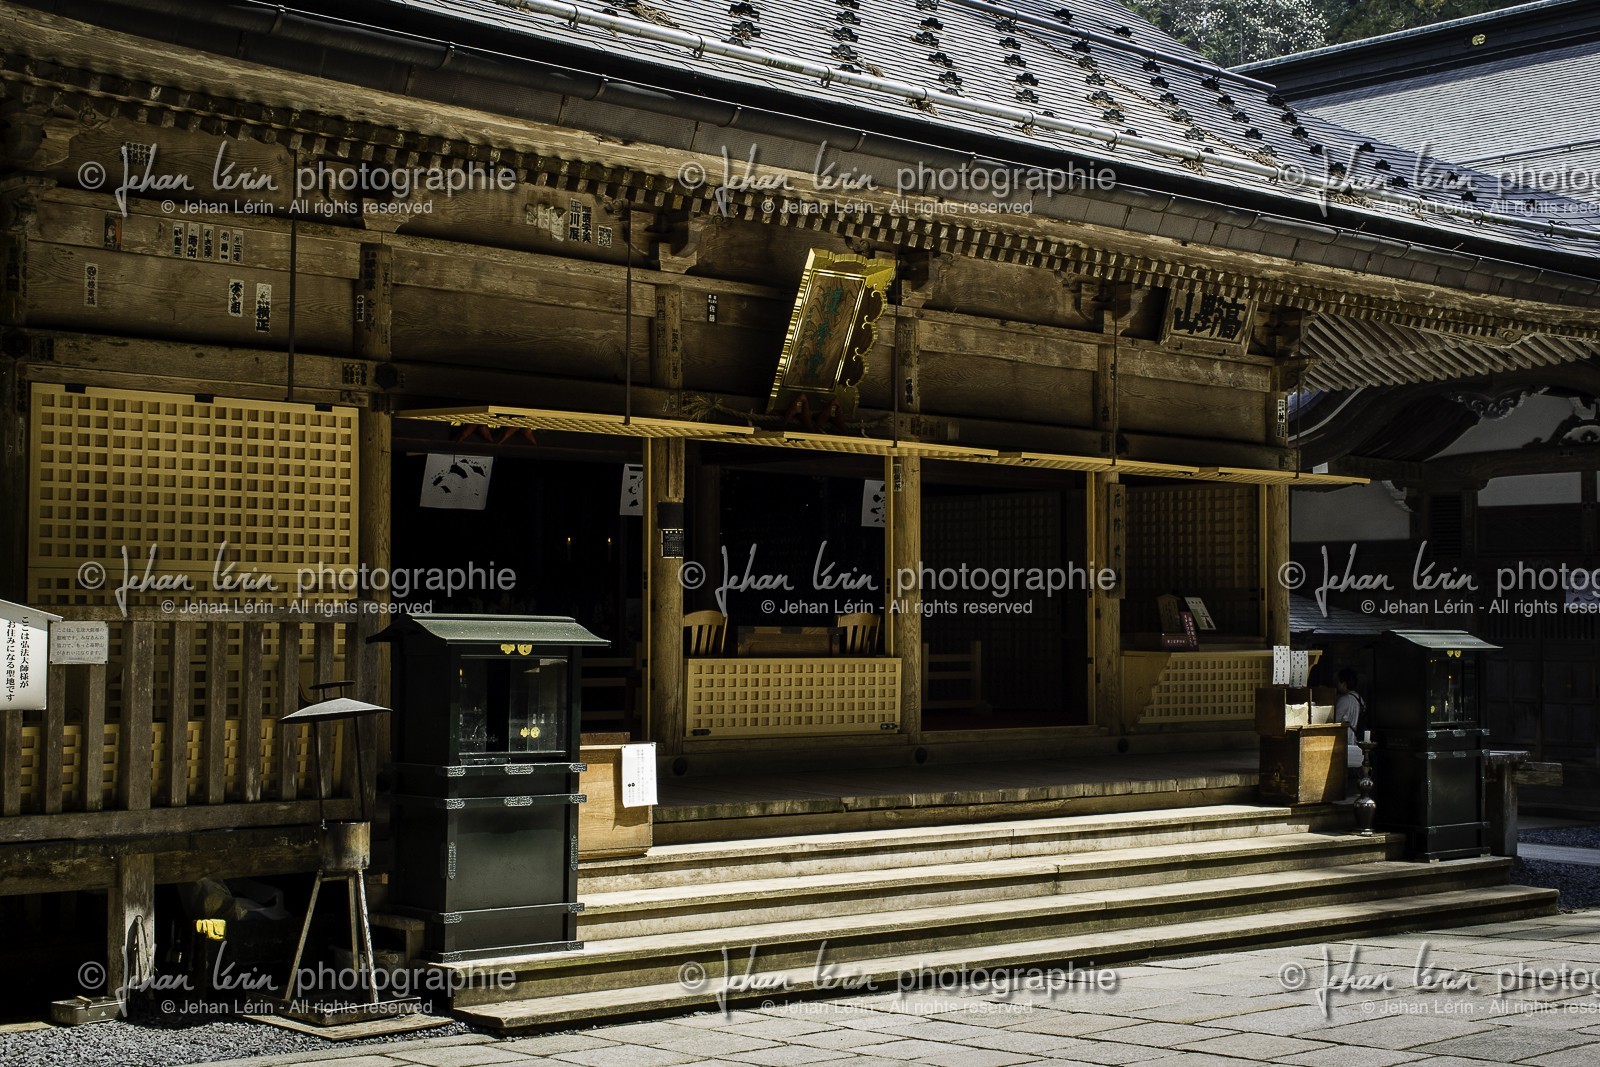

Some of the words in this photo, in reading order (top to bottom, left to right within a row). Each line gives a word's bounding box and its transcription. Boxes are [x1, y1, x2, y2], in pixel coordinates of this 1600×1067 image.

[6, 620, 16, 702] お住みになる聖地です
[20, 616, 30, 688] ここは弘法大師様が
